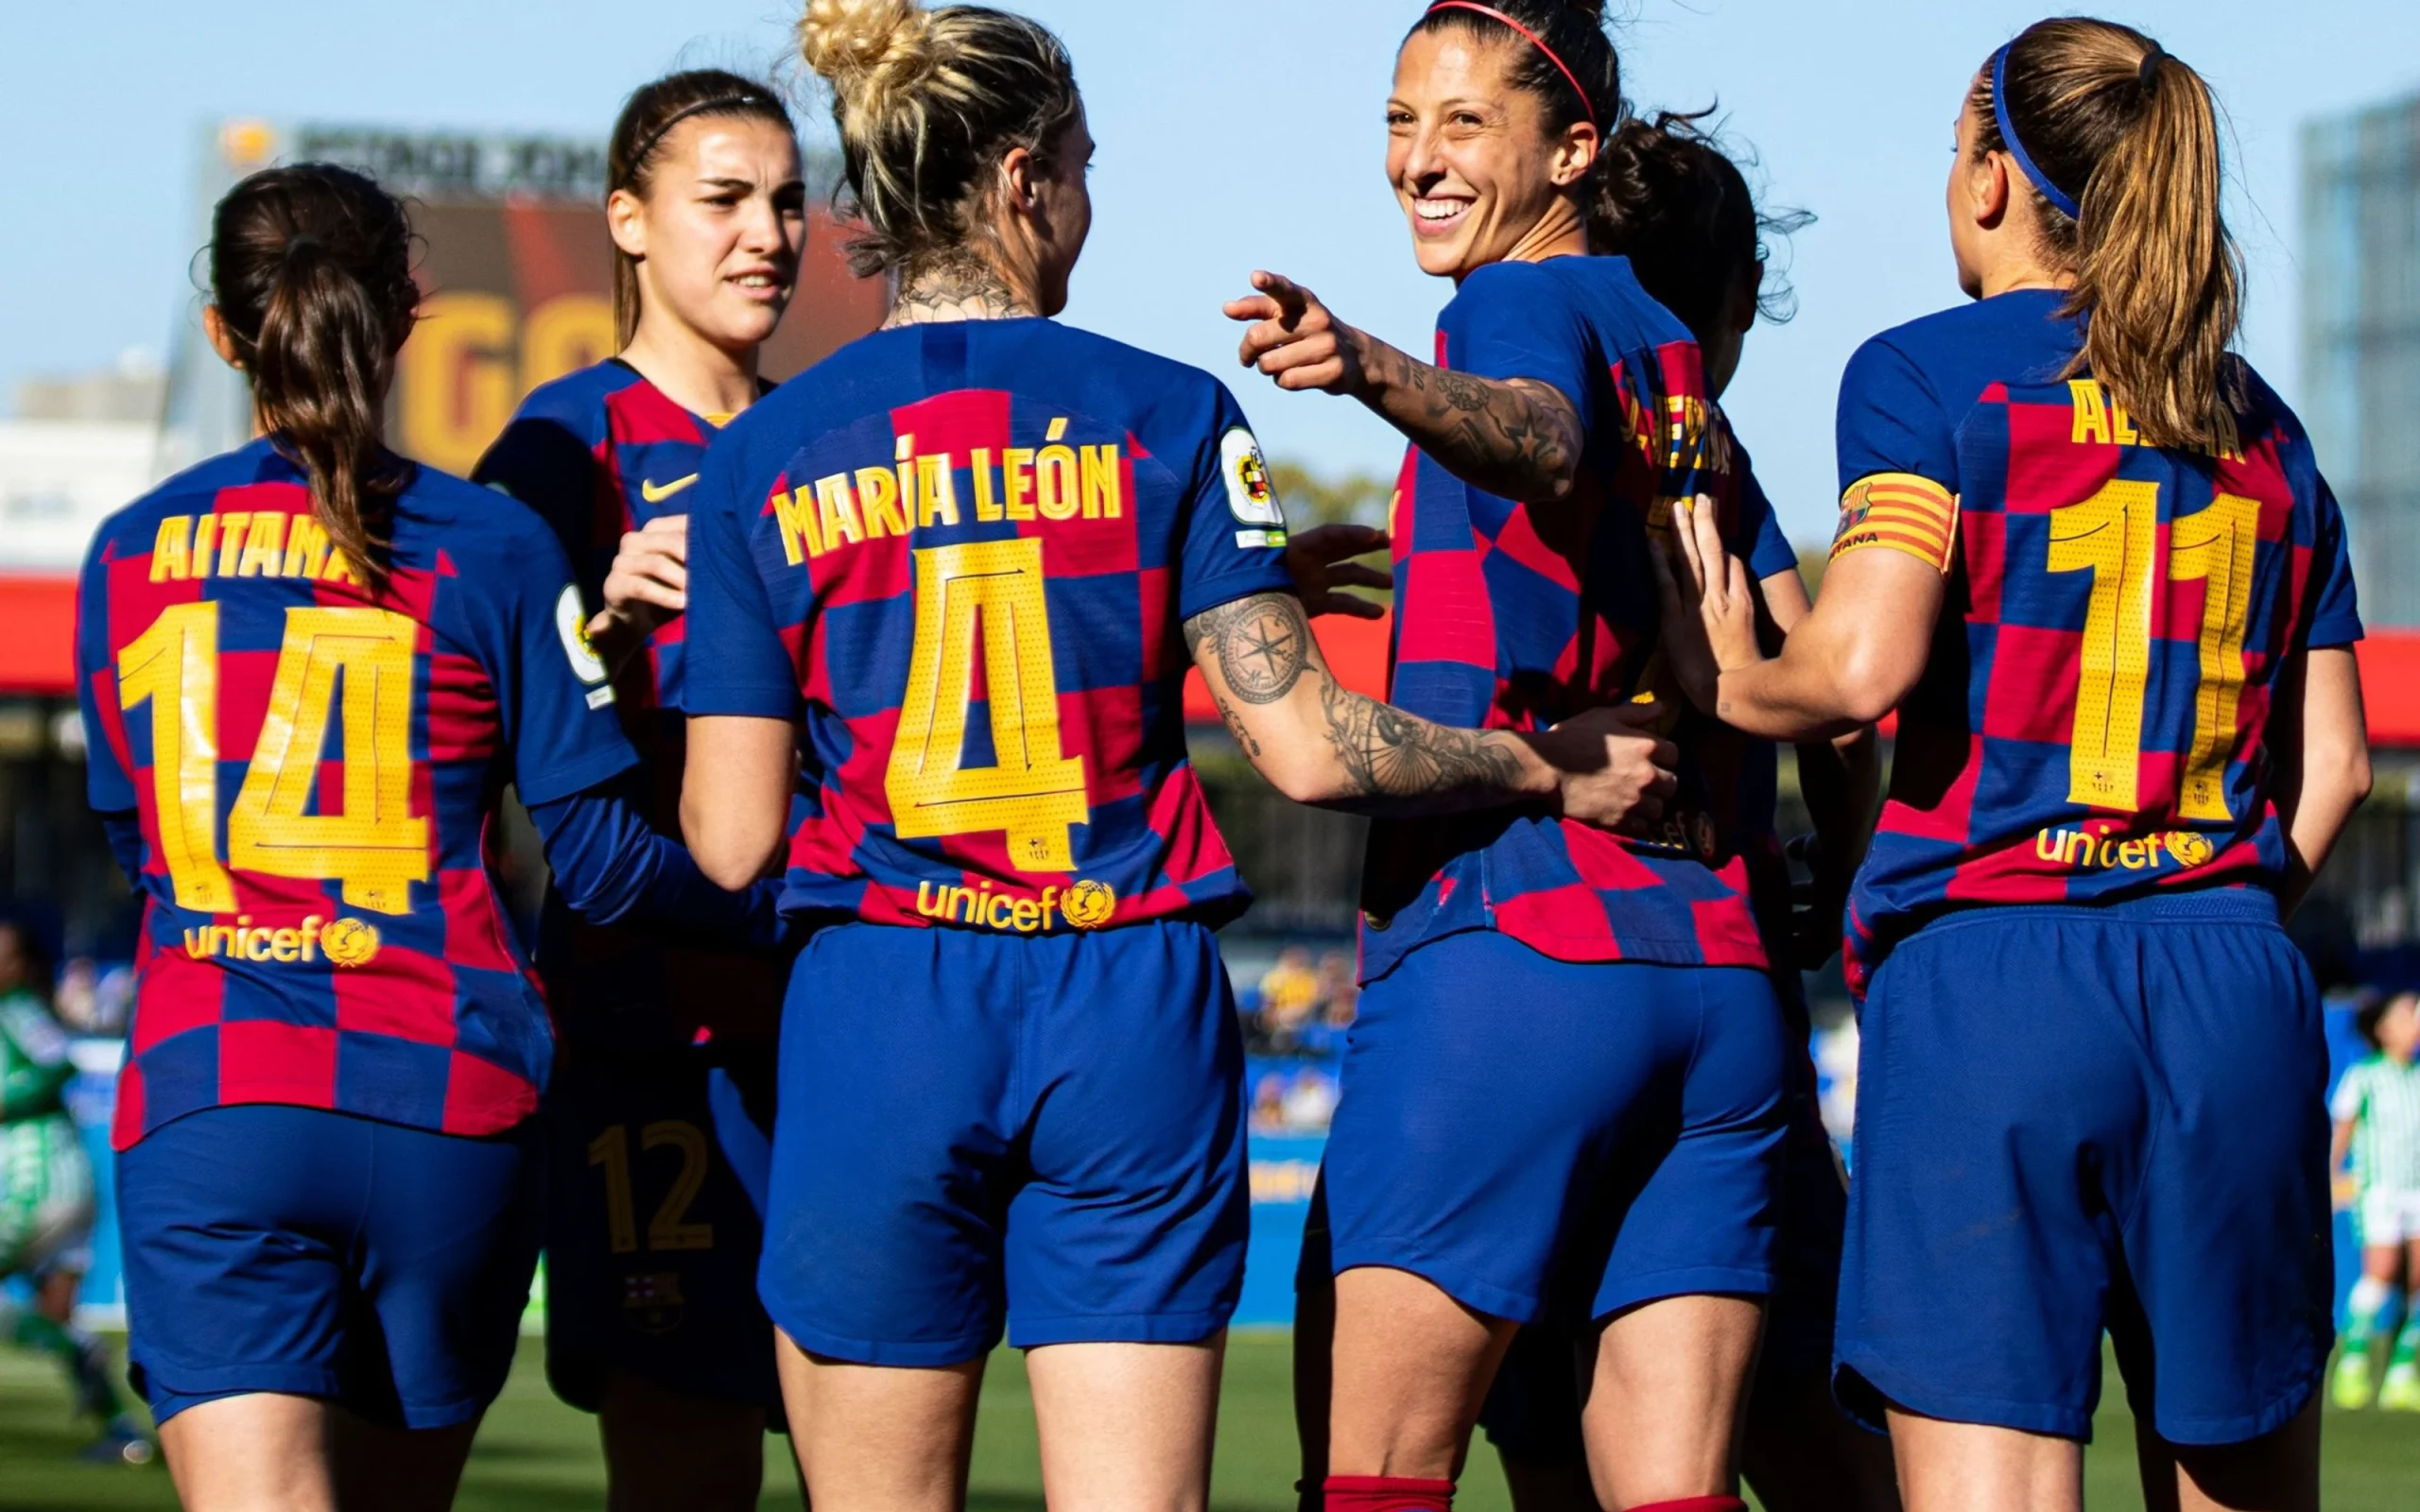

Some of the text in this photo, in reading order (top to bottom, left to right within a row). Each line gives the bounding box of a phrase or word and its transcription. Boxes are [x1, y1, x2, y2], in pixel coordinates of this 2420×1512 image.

[2066, 377, 2245, 463] ALIA
[772, 418, 1121, 565] MARÍA LEÓN
[884, 537, 1090, 872] 4
[2047, 477, 2261, 820] 11
[118, 601, 428, 915] 14
[183, 914, 324, 963] unicef
[916, 880, 1059, 933] unicef
[587, 1119, 715, 1254] 12
